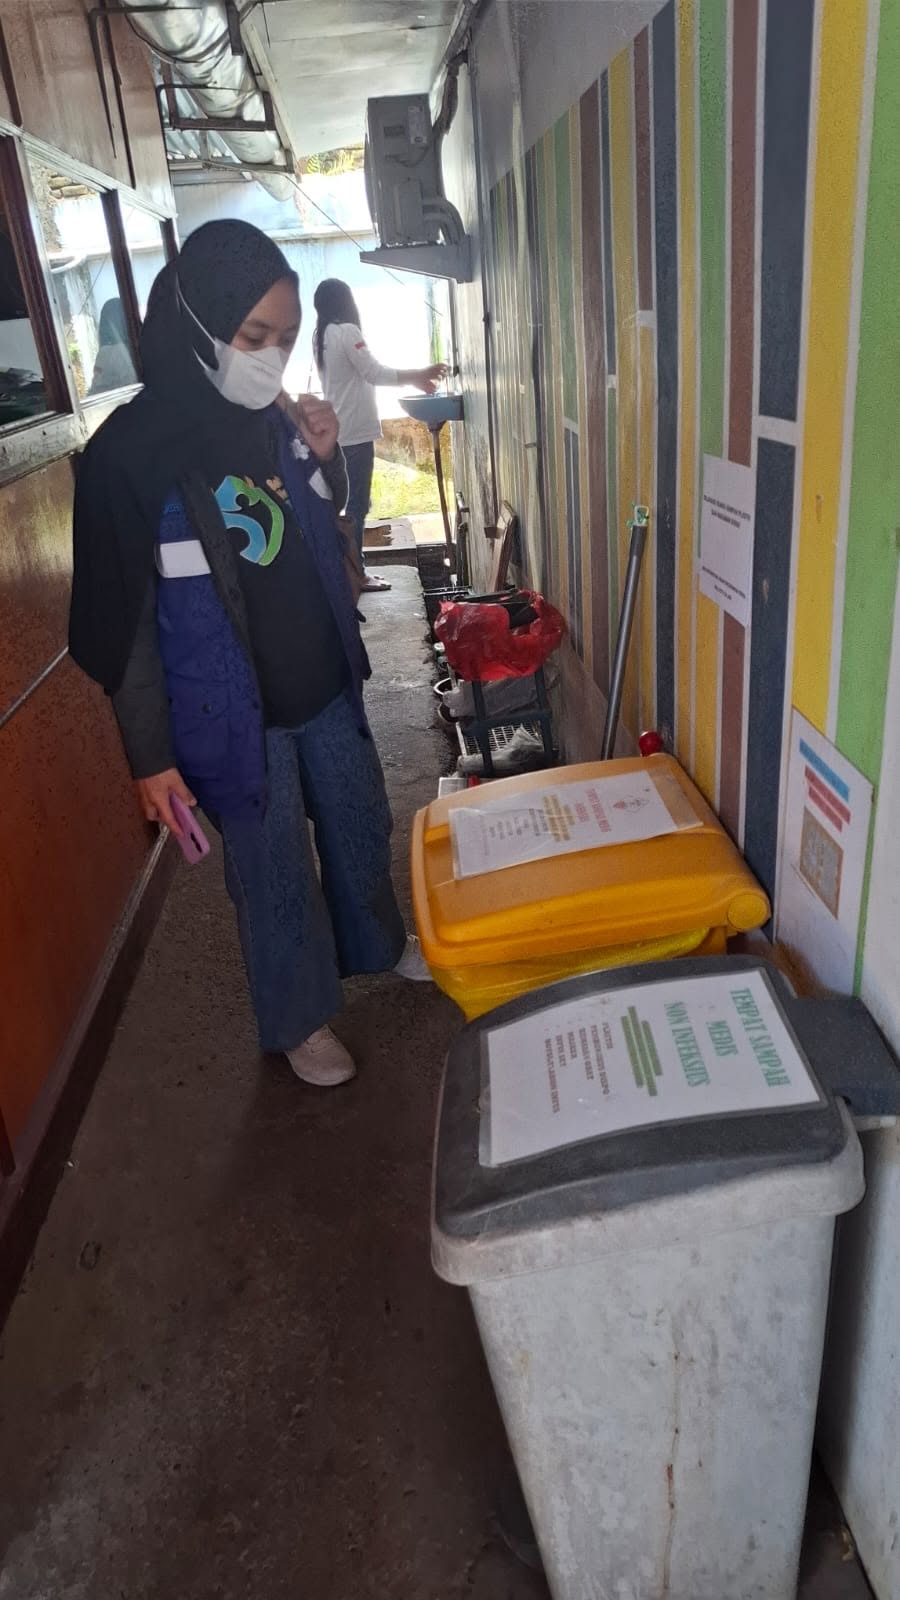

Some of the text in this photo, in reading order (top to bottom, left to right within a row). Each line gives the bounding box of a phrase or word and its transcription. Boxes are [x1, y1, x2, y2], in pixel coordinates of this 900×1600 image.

[664, 1001, 710, 1087] NON INFEKSIUS
[706, 1020, 738, 1057] MEDIS
[729, 987, 791, 1087] TEMPAT SAMPAH
